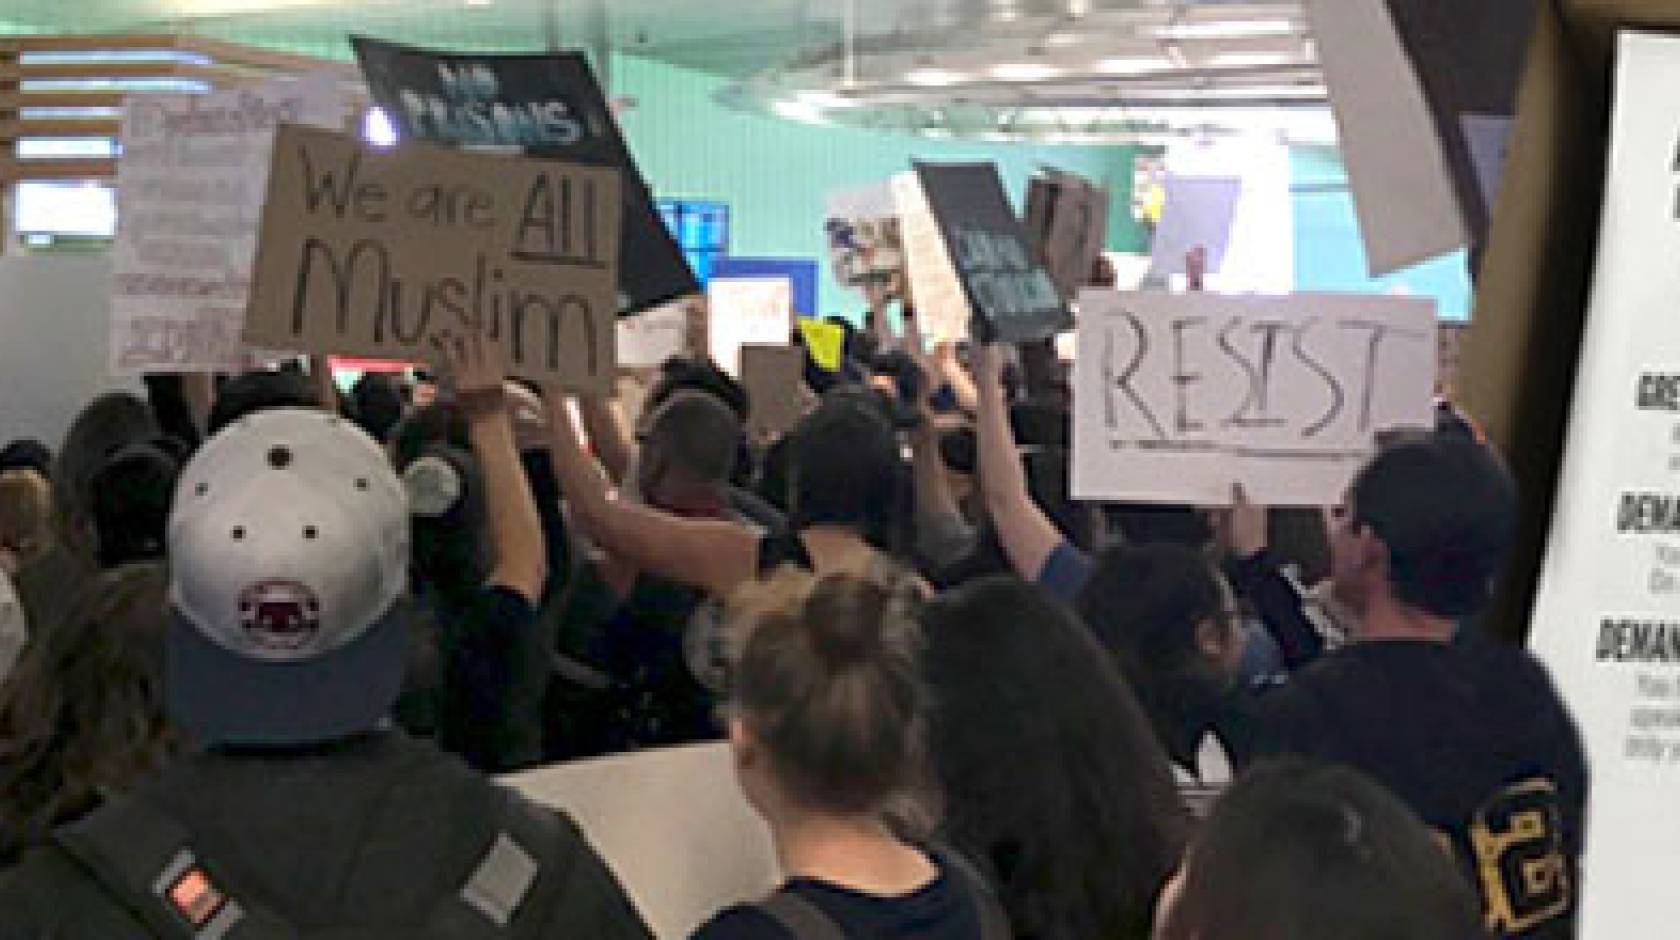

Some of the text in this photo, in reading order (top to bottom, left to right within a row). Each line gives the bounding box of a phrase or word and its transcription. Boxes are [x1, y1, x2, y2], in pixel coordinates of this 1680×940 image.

[297, 146, 388, 222] We
[404, 182, 496, 226] are
[291, 238, 598, 378] Muslim
[1103, 308, 1427, 438] RESIST
